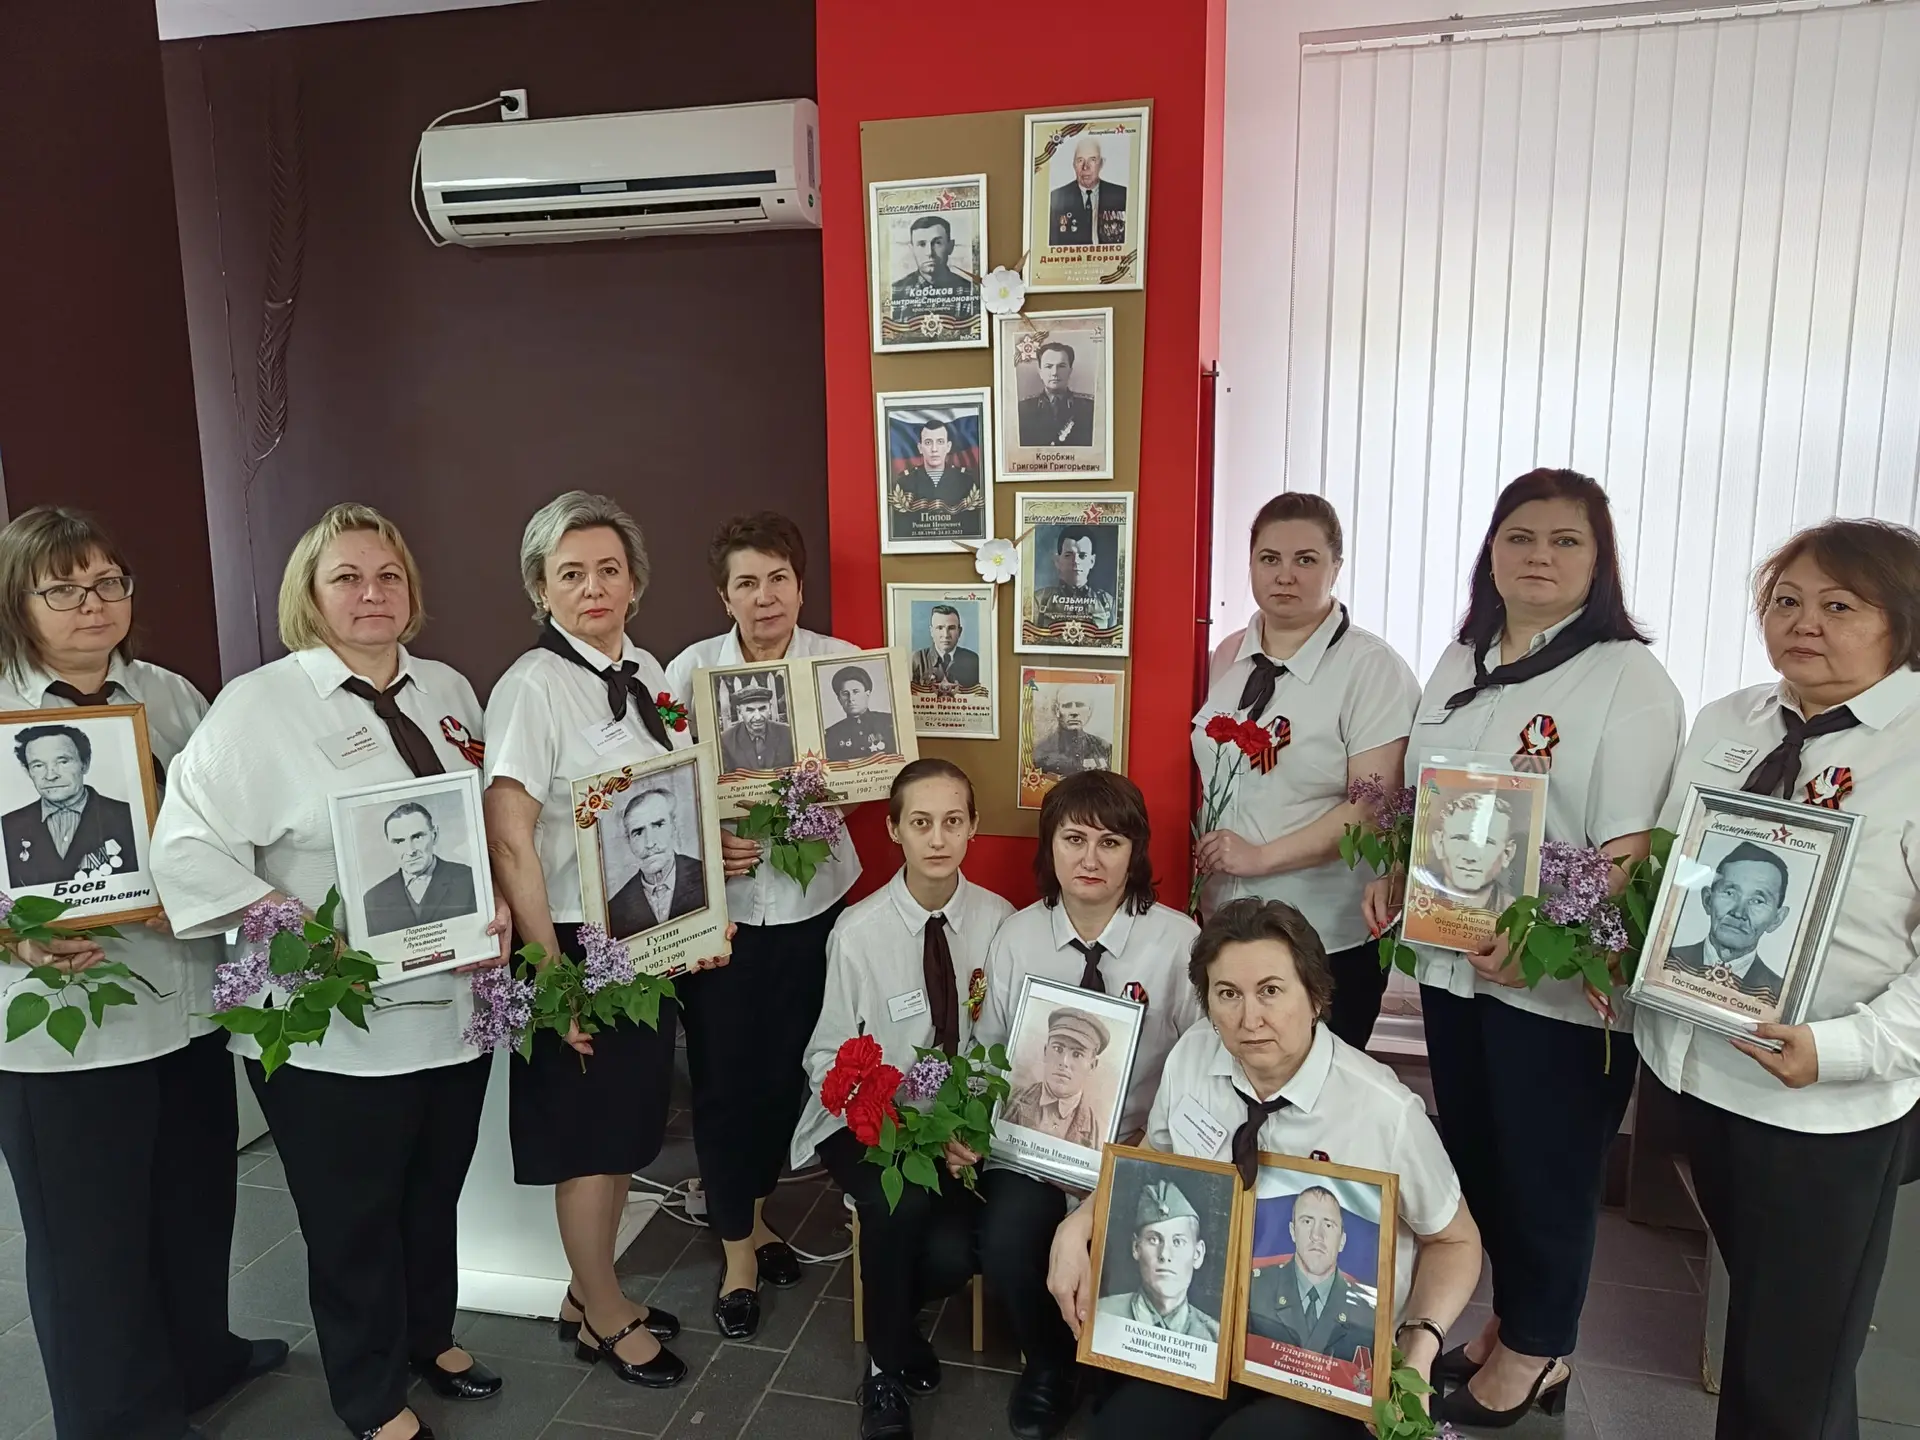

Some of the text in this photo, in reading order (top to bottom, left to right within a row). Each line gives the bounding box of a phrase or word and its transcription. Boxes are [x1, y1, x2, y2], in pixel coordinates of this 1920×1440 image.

[1050, 245, 1122, 254] ГОРЬКОВЕНКО
[1040, 254, 1082, 263] Дмитрий
[909, 287, 954, 297] Кабаков
[1035, 453, 1075, 462] Коробкин
[1012, 462, 1100, 471] Григорий Григорьевич
[920, 512, 952, 521] Попов
[1052, 594, 1096, 605] Казьмин
[730, 783, 767, 793] Кузнецов
[53, 880, 106, 897] Боев
[1457, 914, 1491, 926] Дашков
[403, 929, 448, 944] Константин
[405, 922, 444, 936] Парамонов
[1438, 926, 1457, 936] 1910
[406, 936, 446, 949] Лукьянович
[646, 927, 680, 947] Гулин
[652, 924, 718, 956] Илларионович
[644, 950, 686, 973] 1902-1990
[1671, 975, 1762, 1015] Тастамбеков Салим
[1005, 1133, 1029, 1148] Друзь
[1030, 1141, 1050, 1154] Иван
[1051, 1148, 1091, 1168] Иванович
[1124, 1324, 1208, 1354] ПАХОМОВ ГЕОРГИЙ
[1121, 1343, 1144, 1355] Гвардии
[1144, 1349, 1167, 1361] сержант
[1129, 1337, 1191, 1360] АНИСИМОВИЧ
[1270, 1341, 1339, 1367] Илларионов
[1279, 1354, 1323, 1371] Дмитрий
[1273, 1360, 1331, 1382] Викторович
